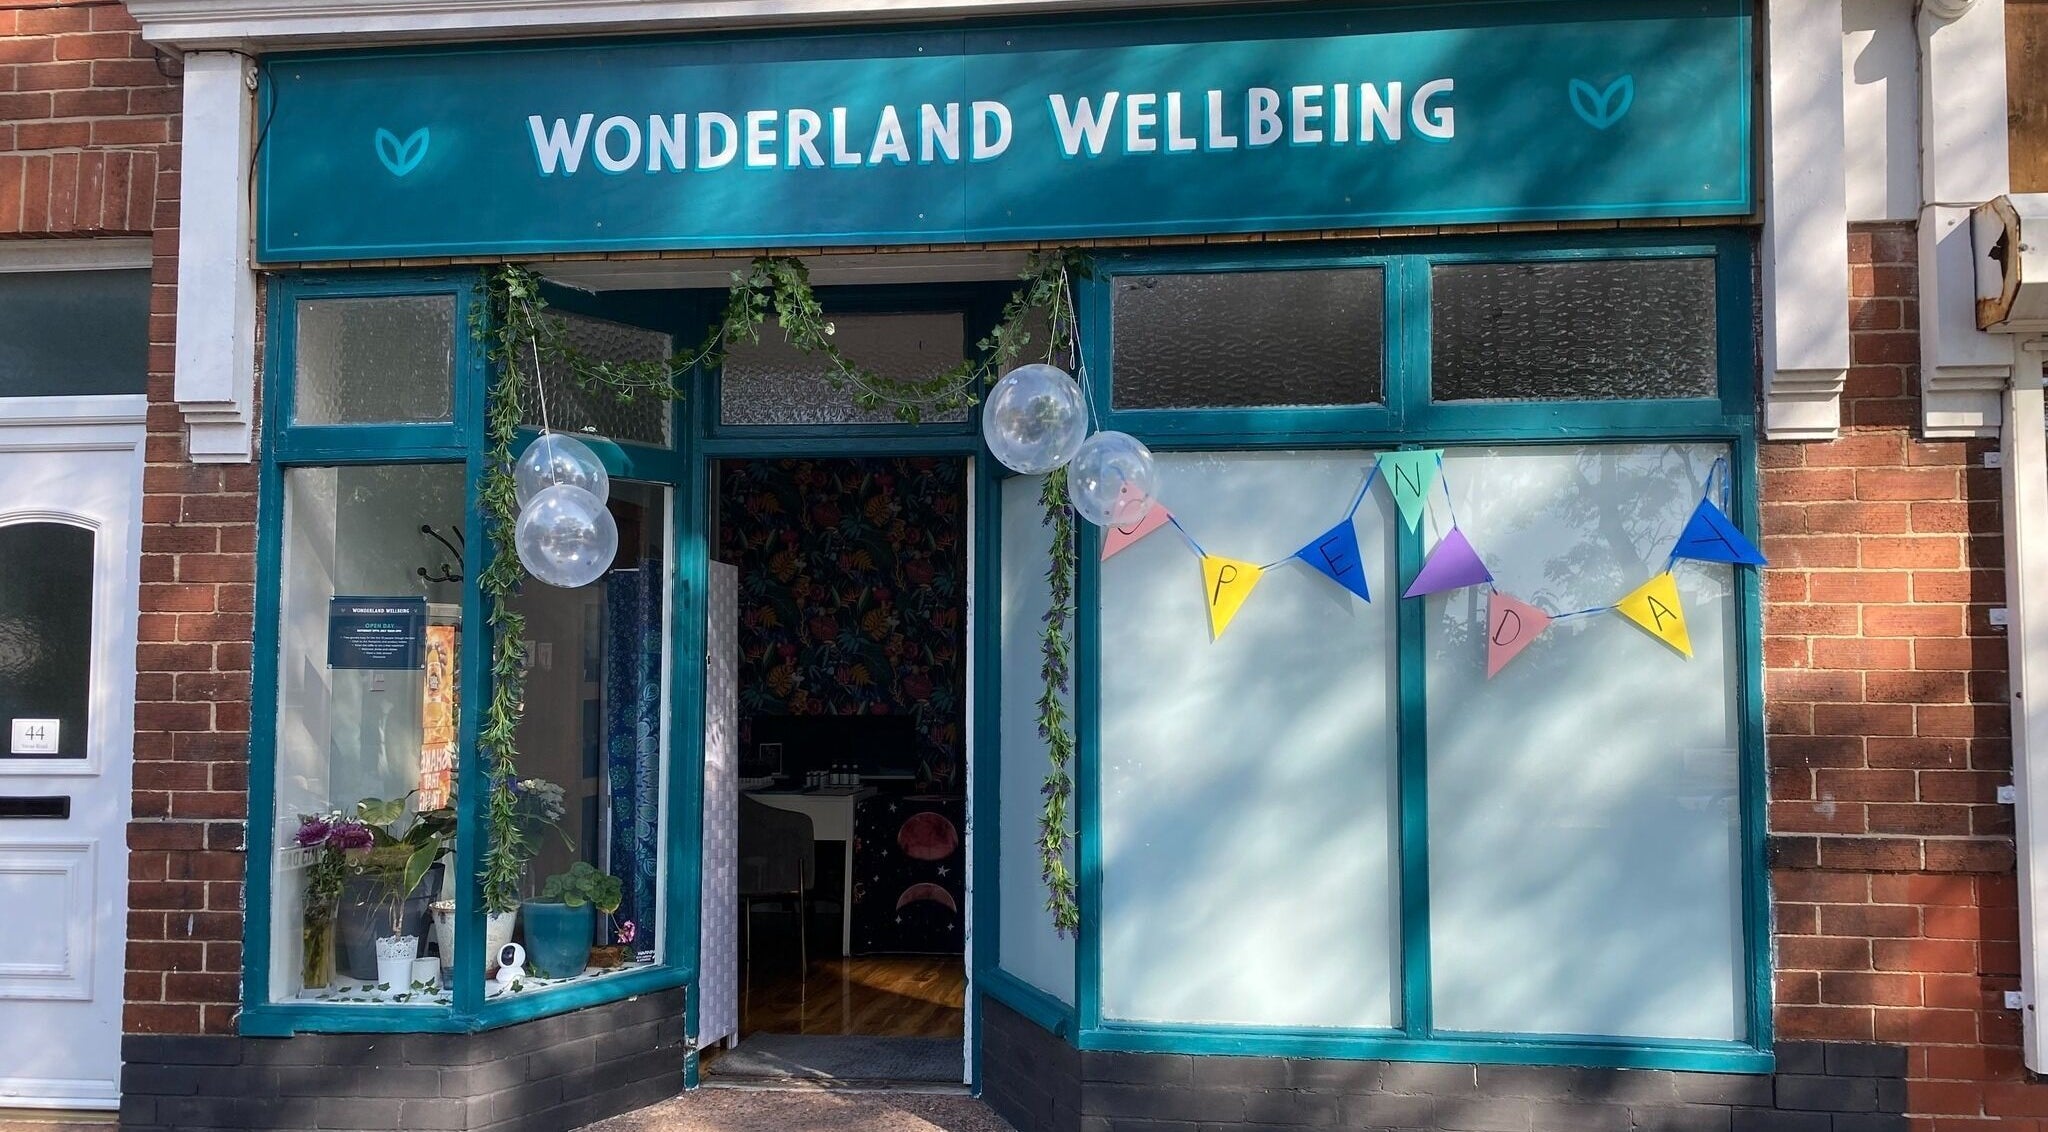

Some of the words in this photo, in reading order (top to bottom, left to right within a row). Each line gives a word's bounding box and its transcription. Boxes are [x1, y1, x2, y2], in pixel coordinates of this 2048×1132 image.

[527, 101, 1012, 174] WONDERLAND
[1048, 78, 1455, 157] WELLBEING
[1492, 514, 1741, 646] DAY
[25, 725, 45, 741] 44
